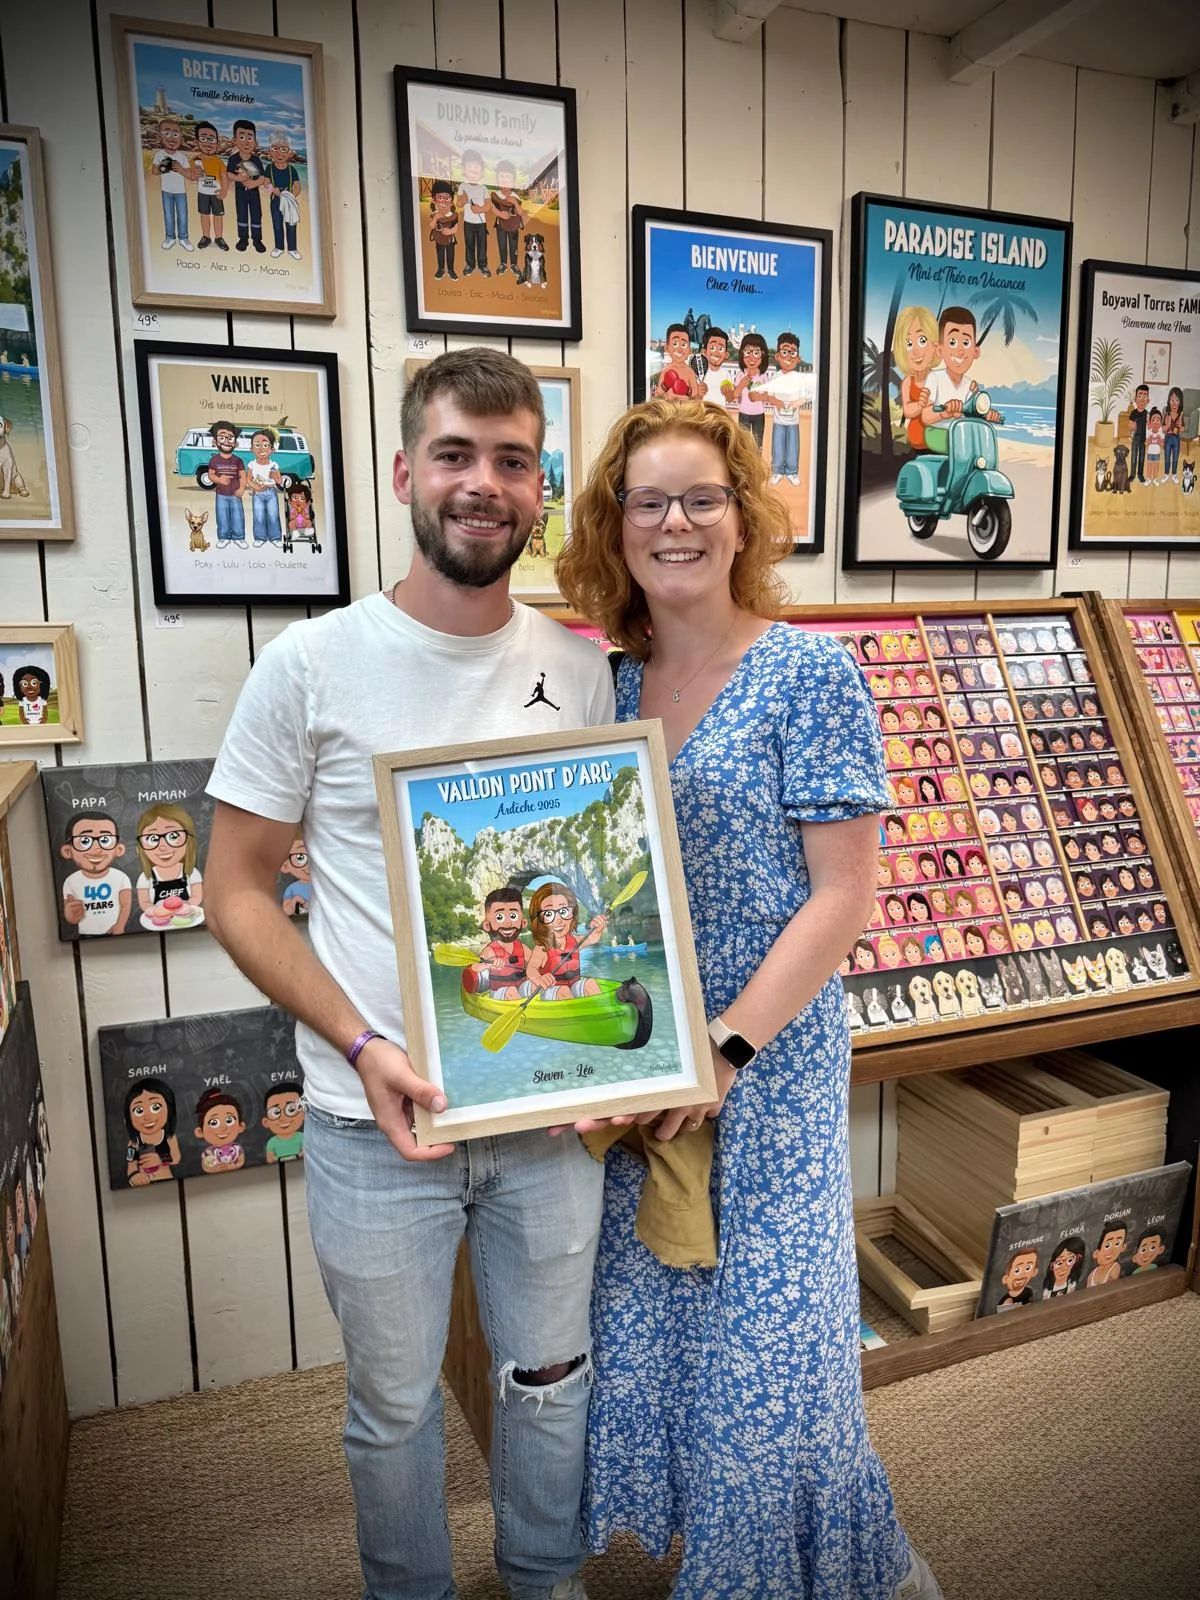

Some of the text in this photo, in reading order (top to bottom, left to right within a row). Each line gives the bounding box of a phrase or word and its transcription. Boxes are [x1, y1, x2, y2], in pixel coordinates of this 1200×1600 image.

[182, 57, 260, 86] BRETAGNE
[190, 86, 221, 100] Famille
[437, 101, 537, 134] DURAND Family
[464, 133, 490, 144] passion
[884, 218, 1048, 270] PARADISE ISLAND
[176, 258, 201, 271] Papa
[210, 261, 228, 272] Alex
[237, 263, 250, 274] JO
[691, 244, 778, 276] BIENVENUE
[907, 263, 1026, 291] Nini et Théo en Vacances
[706, 276, 763, 295] Chez Nous...
[470, 289, 483, 300] Eric
[491, 290, 514, 301] Maud
[1102, 290, 1140, 311] Boyaval
[1143, 293, 1175, 313] Torres
[137, 313, 158, 327] 49€
[1121, 315, 1192, 334] Bienvenue chez Nous
[413, 339, 430, 350] 49€
[210, 374, 270, 395] VANLIFE
[235, 402, 254, 413] plein
[255, 403, 264, 412] le
[264, 405, 278, 413] van
[194, 560, 213, 570] Poky
[223, 561, 239, 569] Lulu
[275, 561, 308, 570] Poulette
[164, 613, 181, 624] 49€
[438, 760, 613, 804] VALLON PONT D'ARC
[137, 788, 187, 802] MAMAN
[71, 796, 107, 809] PAPA
[538, 798, 561, 812] 2025
[84, 883, 112, 901] 40
[159, 888, 184, 898] CHEF
[84, 900, 114, 911] YEARS
[128, 1064, 167, 1078] SARAH
[270, 1070, 299, 1082] EYAL
[532, 1063, 596, 1084] Steven Léa
[203, 1074, 232, 1087] YAËL
[1103, 1207, 1132, 1222] DORIAN
[1147, 1214, 1166, 1225] LÉON
[1008, 1235, 1045, 1250] STÉPHANE
